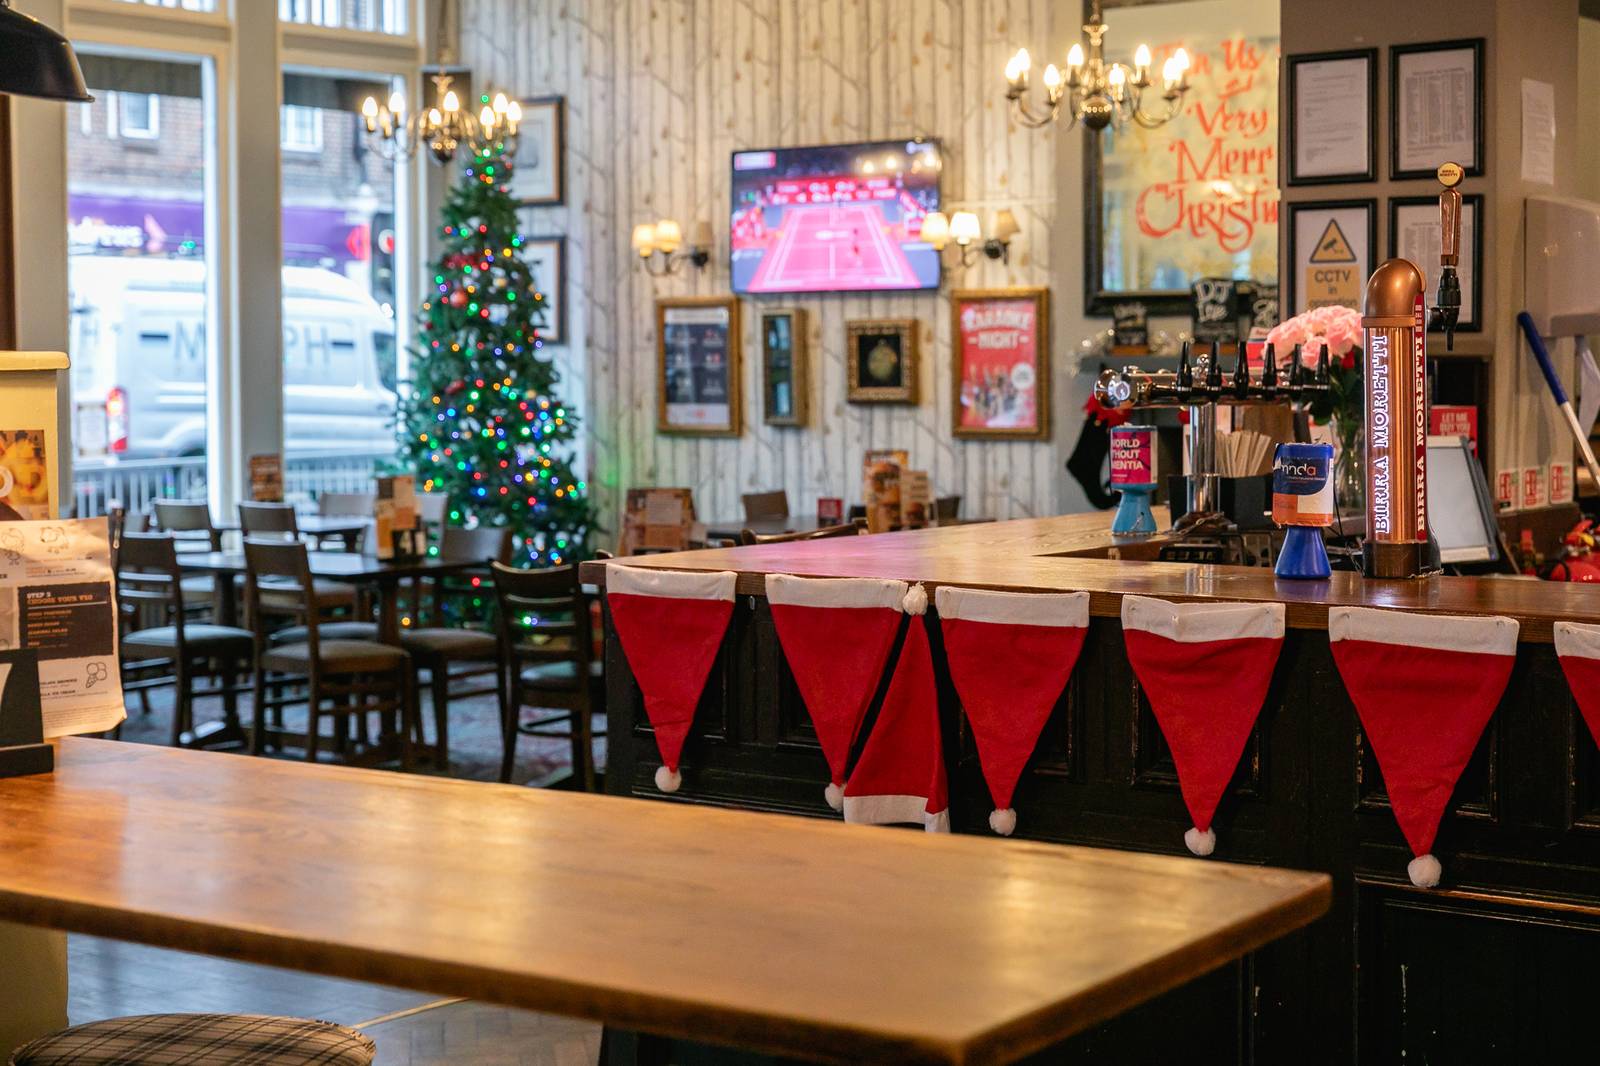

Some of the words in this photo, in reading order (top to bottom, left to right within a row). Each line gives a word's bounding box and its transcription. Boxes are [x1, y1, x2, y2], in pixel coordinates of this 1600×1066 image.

[1186, 99, 1268, 139] Very
[1168, 136, 1275, 183] Merr
[1314, 269, 1352, 283] CCTV
[1371, 335, 1388, 449] MORETTI
[1415, 336, 1425, 447] MORETTI
[1374, 455, 1390, 534] BIRRA
[1416, 455, 1425, 533] BIRRA
